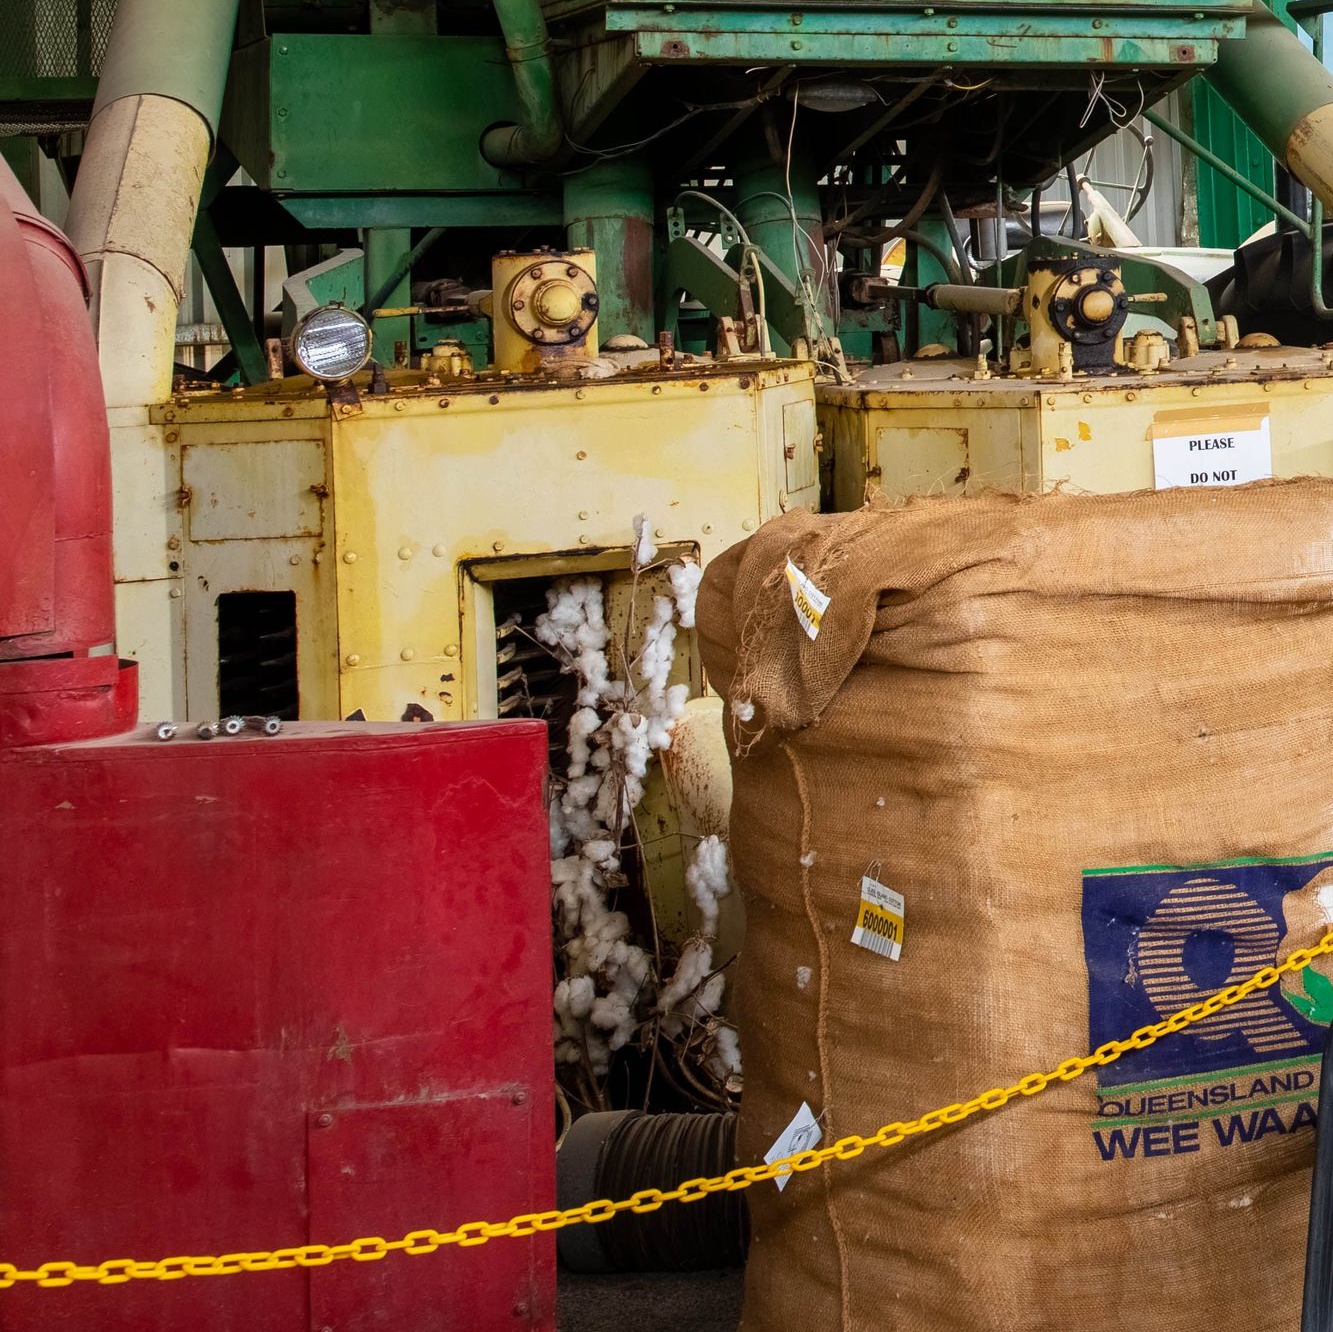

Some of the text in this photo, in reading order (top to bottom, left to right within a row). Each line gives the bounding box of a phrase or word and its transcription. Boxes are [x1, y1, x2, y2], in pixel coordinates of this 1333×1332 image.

[1189, 437, 1236, 451] PLEASE
[1190, 469, 1238, 484] DO NOT
[863, 909, 898, 942] 6000001
[1100, 1070, 1315, 1117] QUEENSLAND
[1092, 1101, 1318, 1162] WEE WAA
